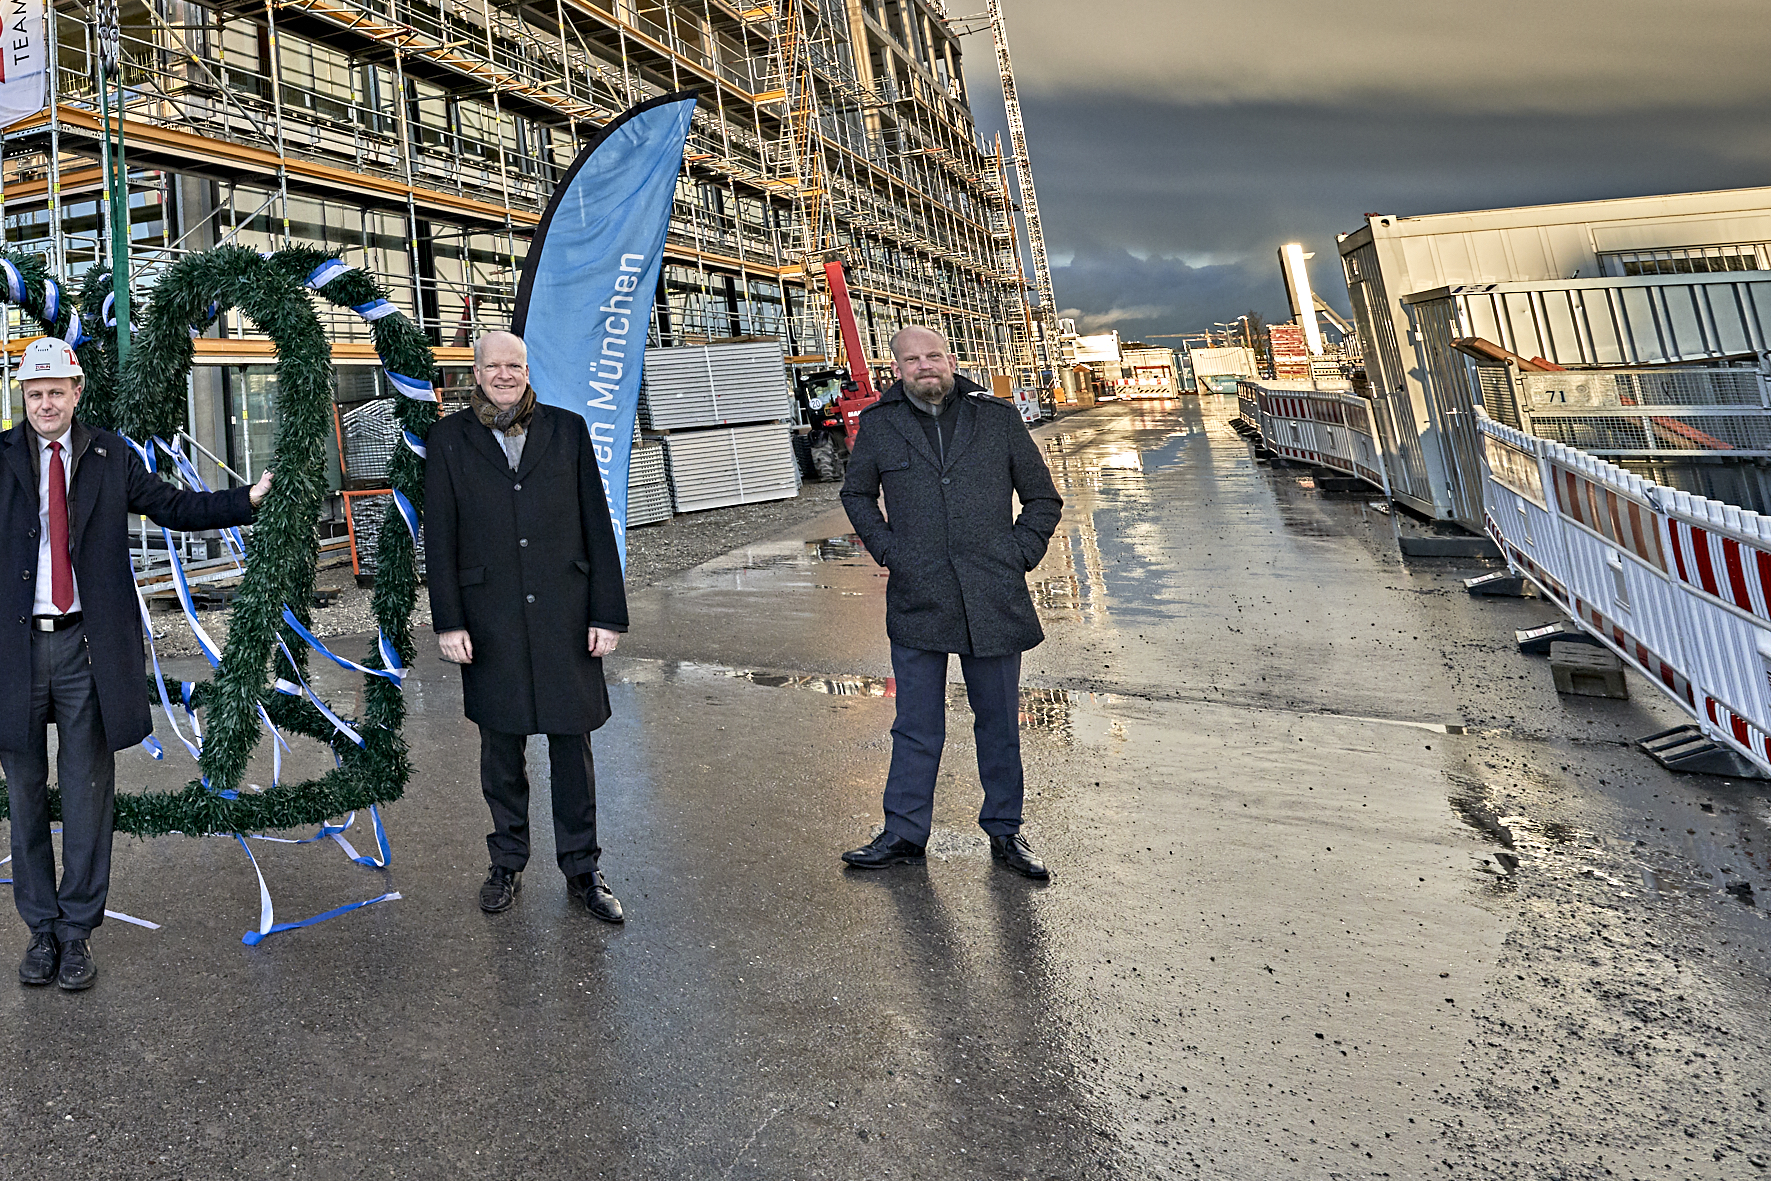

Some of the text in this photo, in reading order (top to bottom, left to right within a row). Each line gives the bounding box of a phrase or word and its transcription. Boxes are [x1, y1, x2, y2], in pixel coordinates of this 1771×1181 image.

[587, 253, 644, 410] München
[1545, 390, 1566, 403] 71
[812, 400, 821, 409] 20
